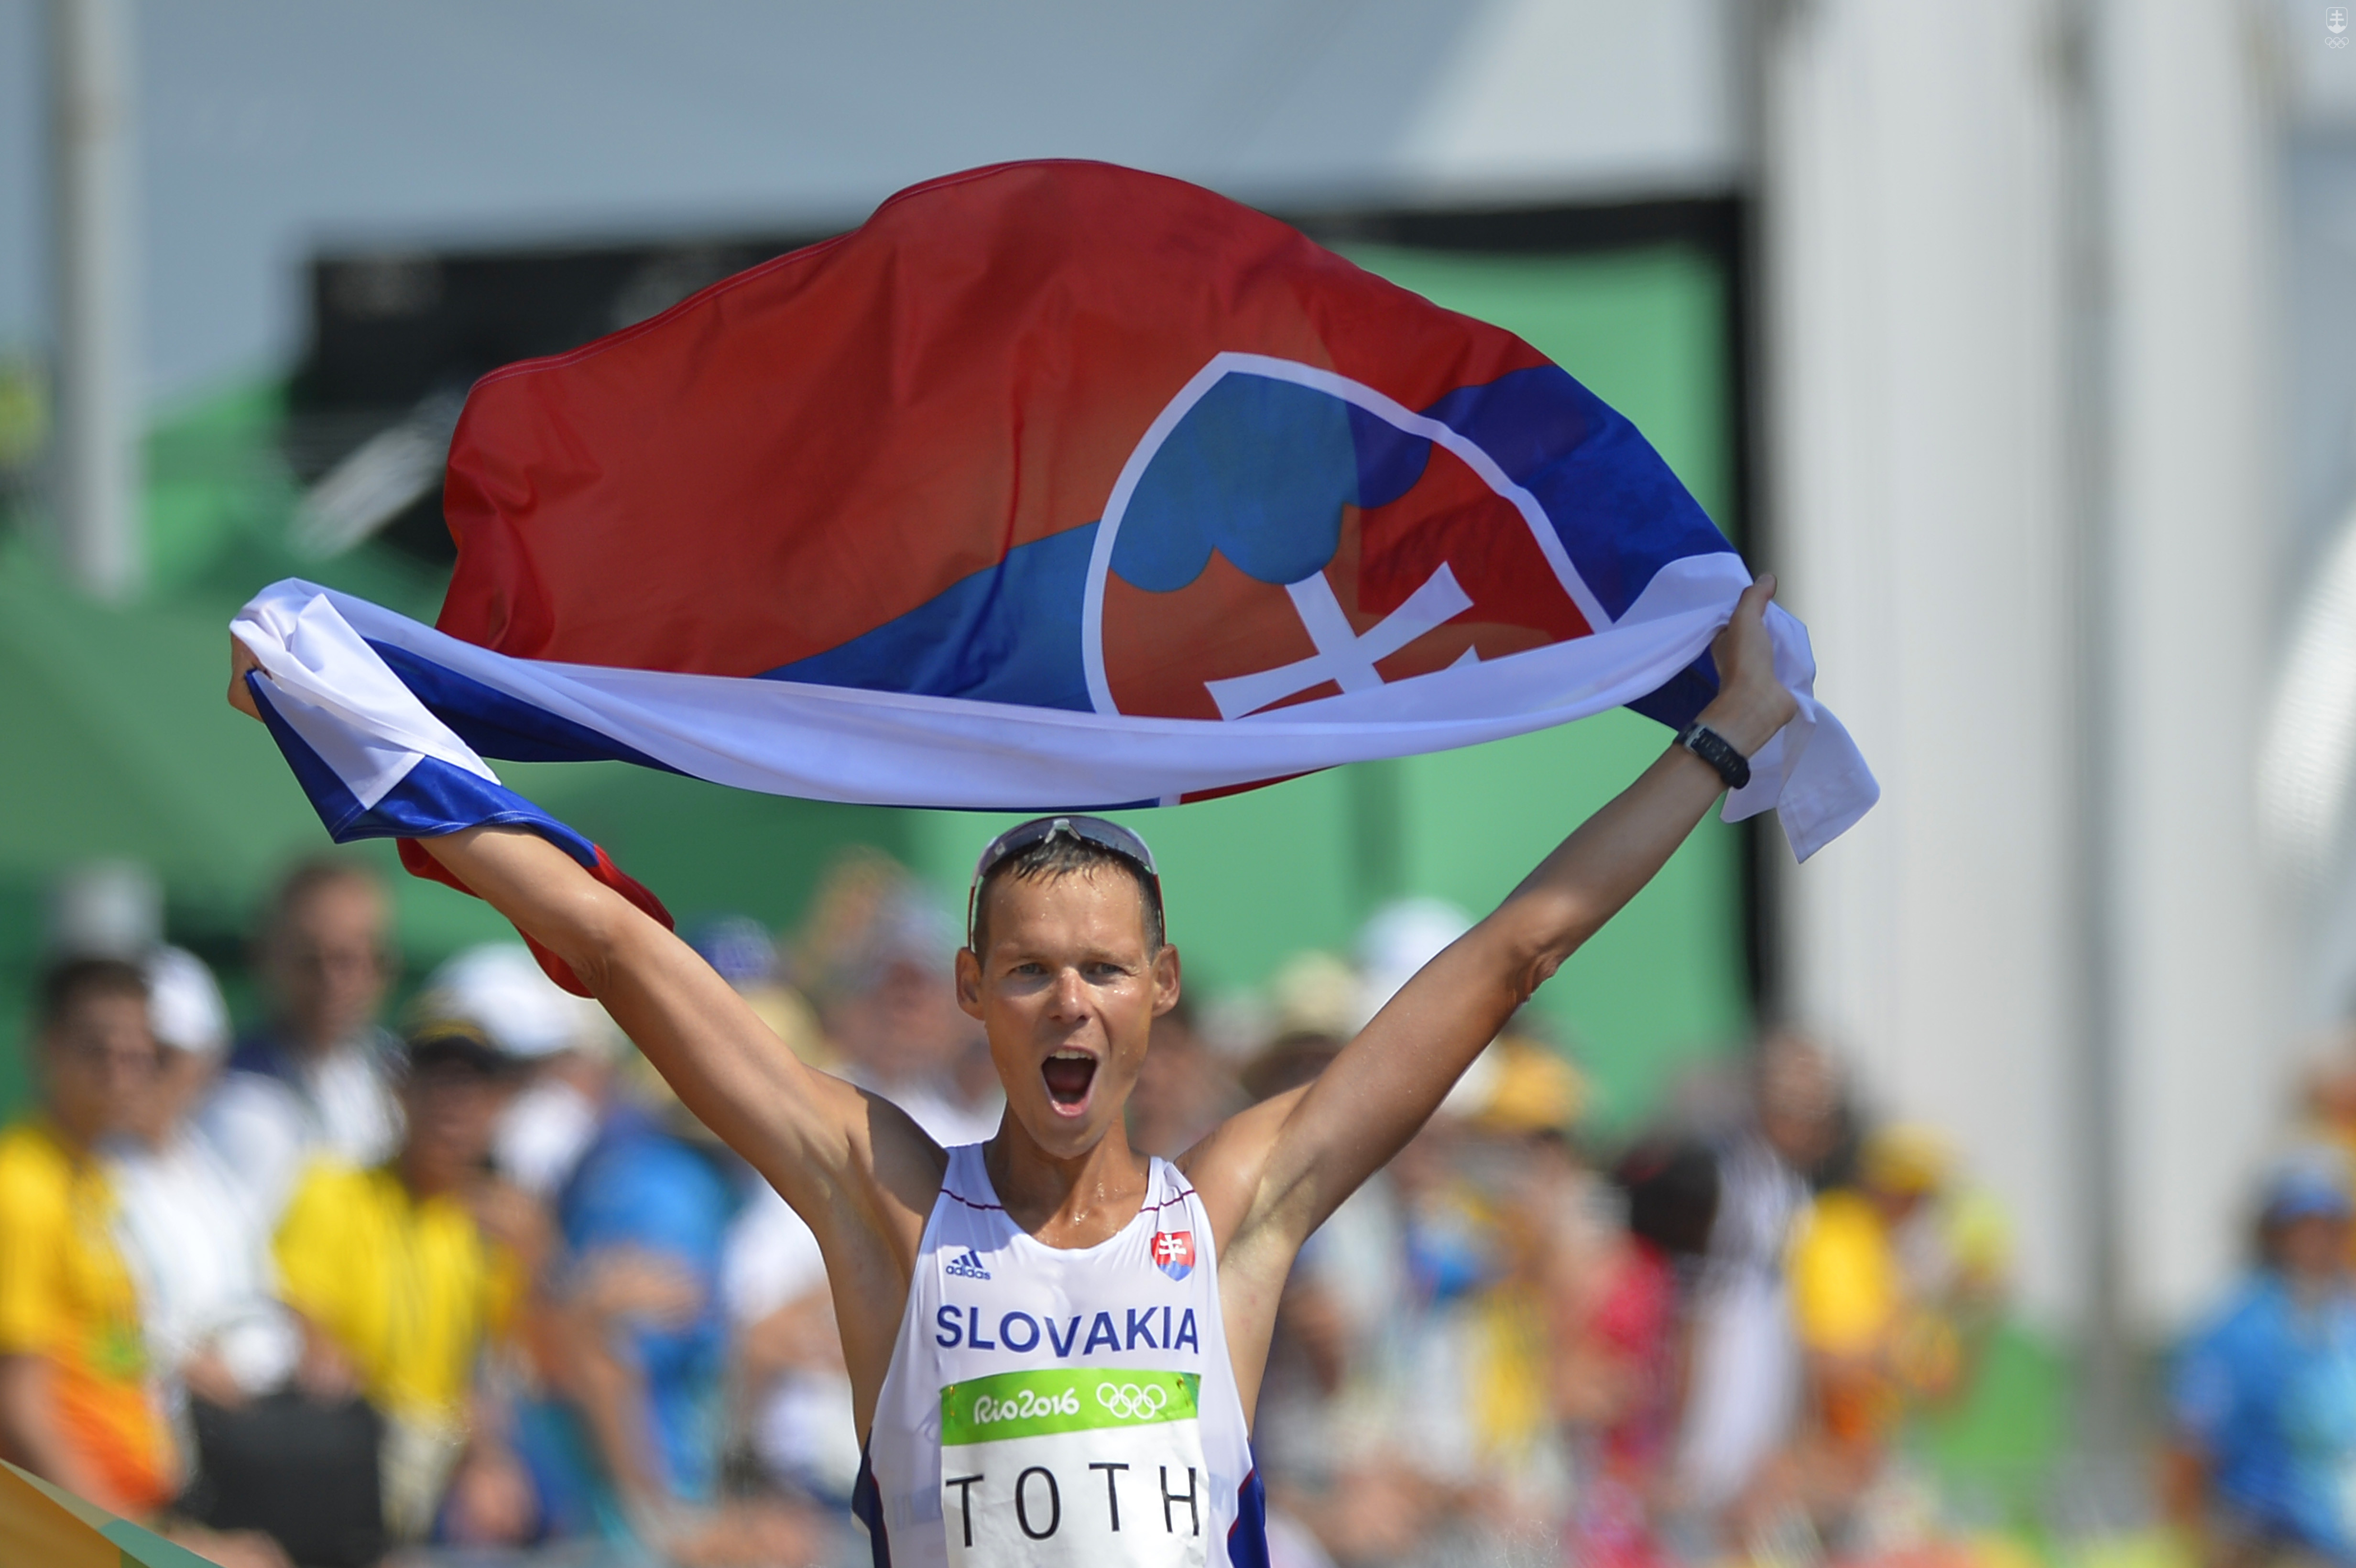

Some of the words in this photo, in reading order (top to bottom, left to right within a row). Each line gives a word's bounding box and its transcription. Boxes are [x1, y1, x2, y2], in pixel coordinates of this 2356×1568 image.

[946, 1264, 991, 1280] adidas
[936, 1305, 1199, 1357] SLOVAKIA
[946, 1462, 1200, 1548] TOTH
